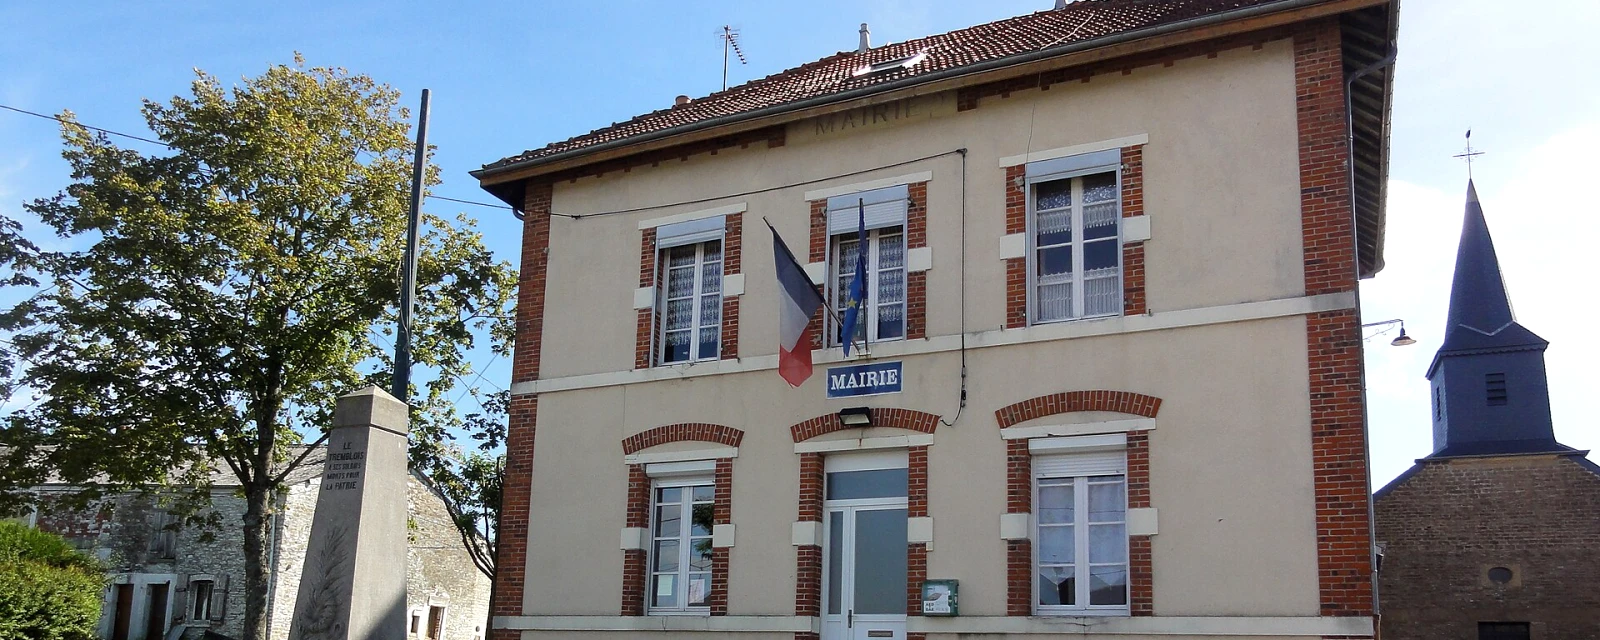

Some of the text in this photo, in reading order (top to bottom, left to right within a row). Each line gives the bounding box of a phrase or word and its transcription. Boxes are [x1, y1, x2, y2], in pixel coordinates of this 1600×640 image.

[815, 98, 920, 135] MAIRIE
[831, 369, 898, 390] MAIRIE
[329, 452, 364, 461] TREMBLOIS
[335, 481, 357, 490] PATRIE
